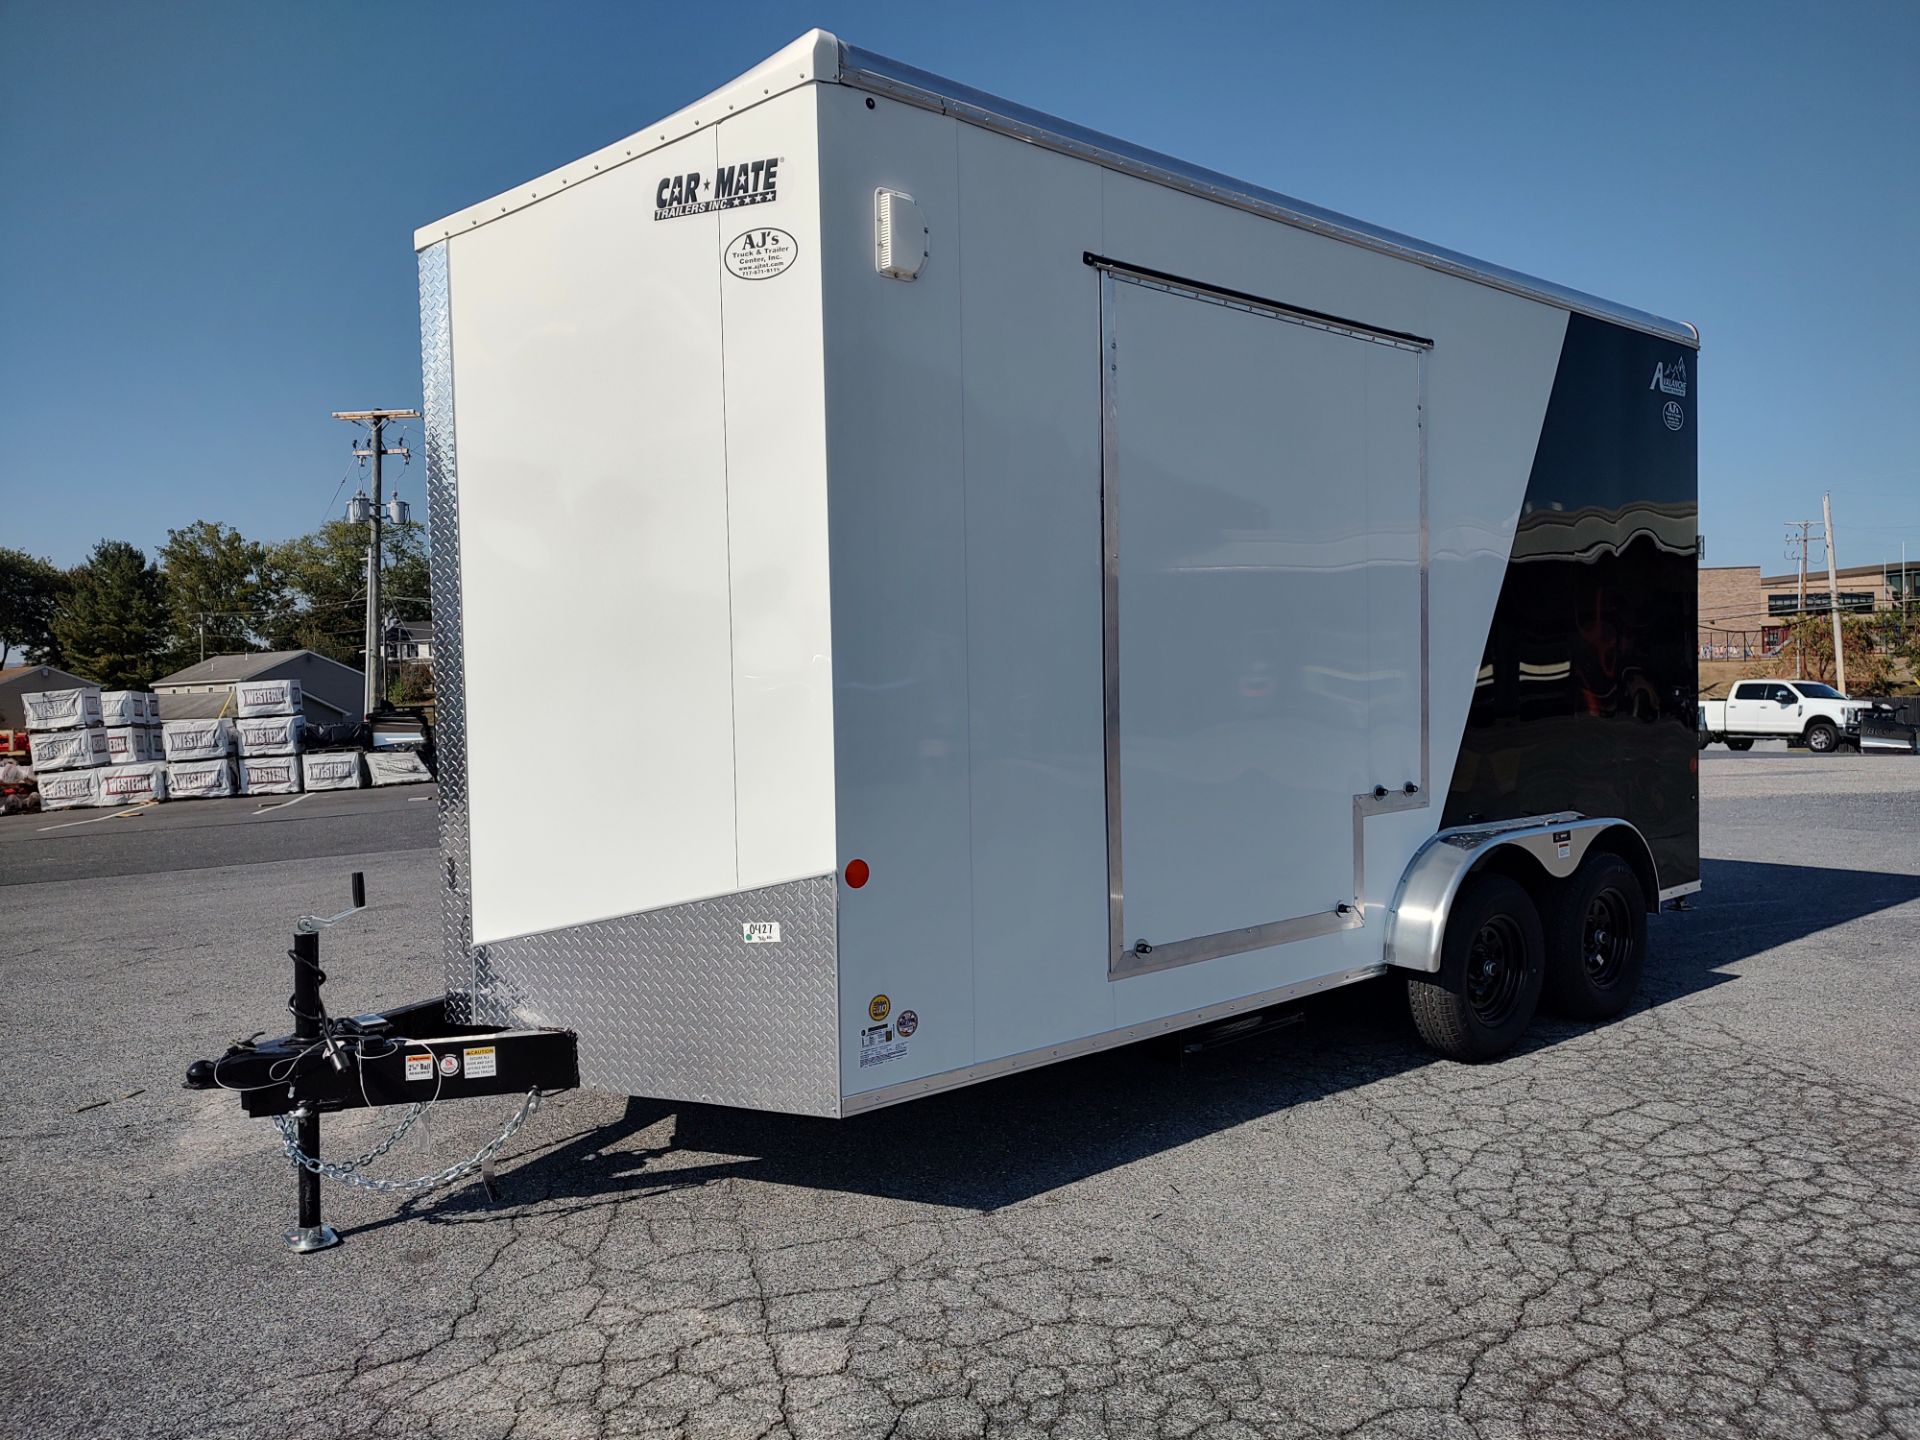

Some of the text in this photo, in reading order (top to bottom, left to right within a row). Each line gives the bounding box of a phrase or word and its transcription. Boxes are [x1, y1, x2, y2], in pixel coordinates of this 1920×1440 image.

[656, 158, 779, 209] CAR MATE
[655, 202, 706, 220] TRAILERS
[742, 231, 780, 250] AJ's
[732, 250, 753, 258] Truck
[764, 246, 789, 254] Trailer
[243, 689, 283, 705] WESTERN
[171, 731, 215, 750] WESTERN
[245, 728, 286, 745] WESTERN
[249, 767, 289, 783] WESTERN
[311, 762, 350, 779] WESTERN
[107, 776, 150, 793] WESTERN
[176, 772, 219, 789] WESTERN
[749, 923, 773, 935] 0427
